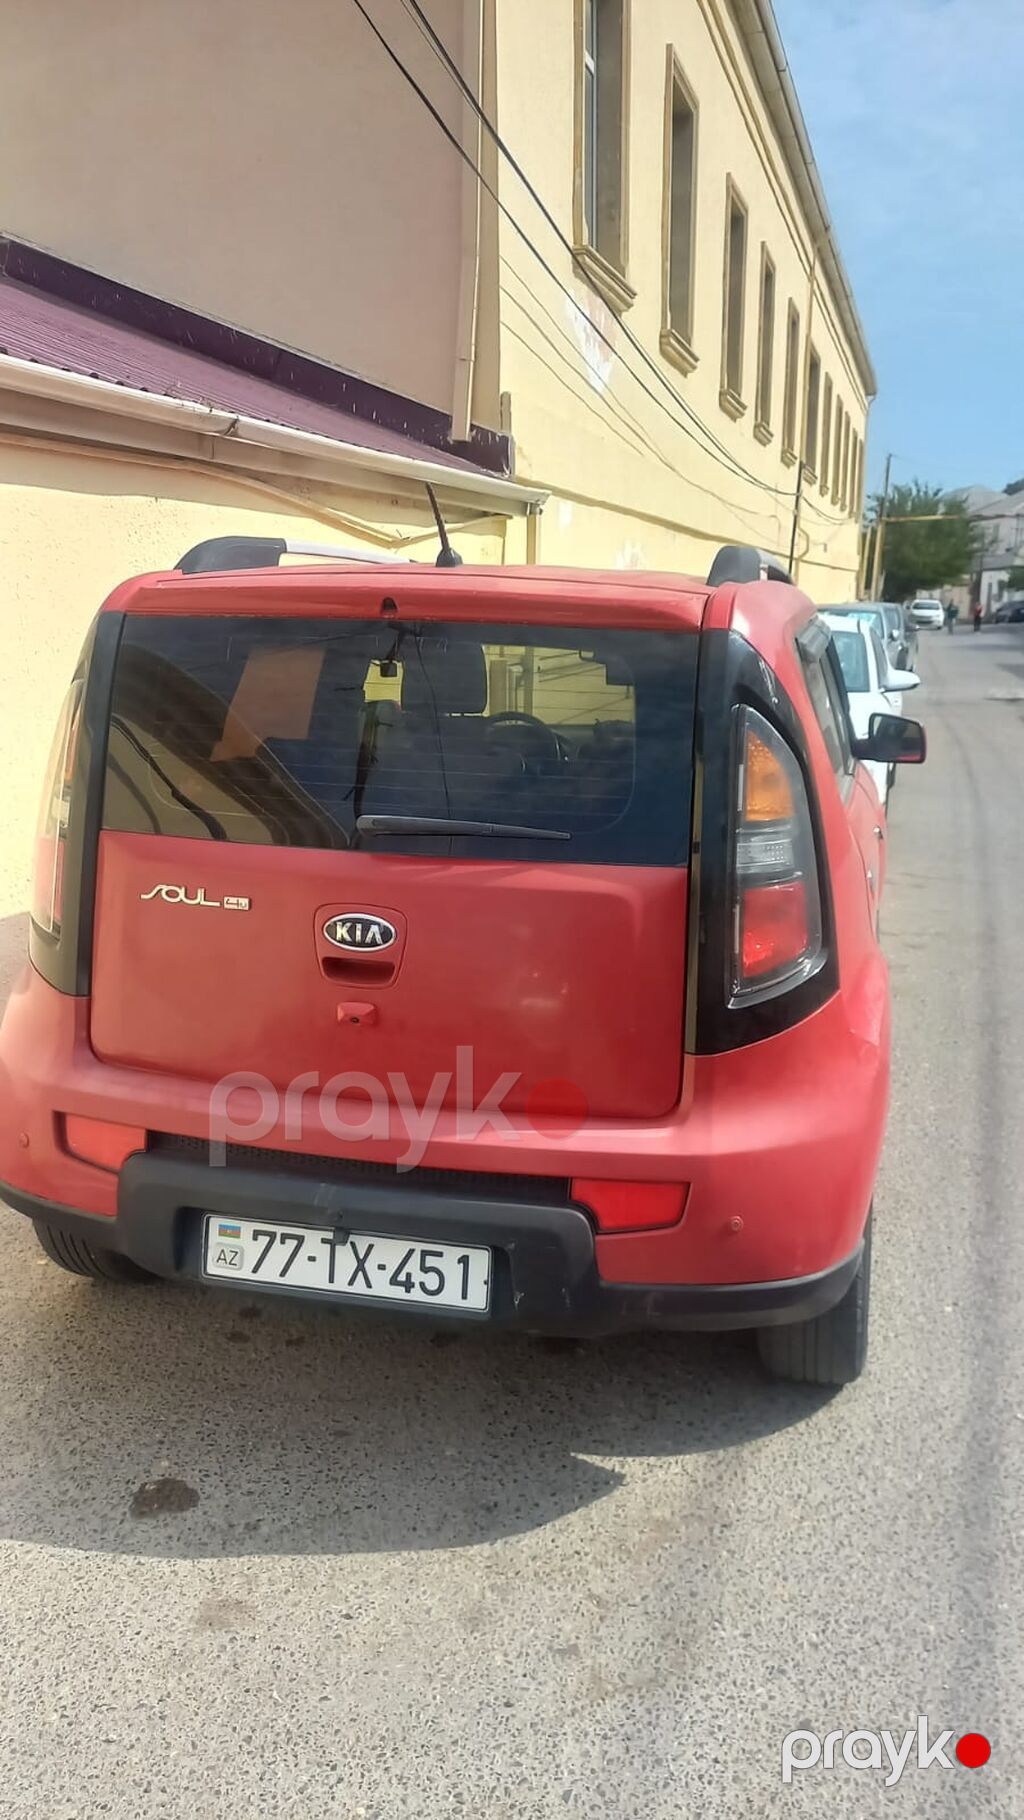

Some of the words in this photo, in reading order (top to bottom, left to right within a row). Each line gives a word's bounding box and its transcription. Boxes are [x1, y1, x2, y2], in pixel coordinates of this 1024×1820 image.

[140, 884, 221, 907] SOUL
[336, 922, 383, 945] KIA
[216, 1247, 239, 1267] AZ
[251, 1228, 470, 1301] 77-TX-451
